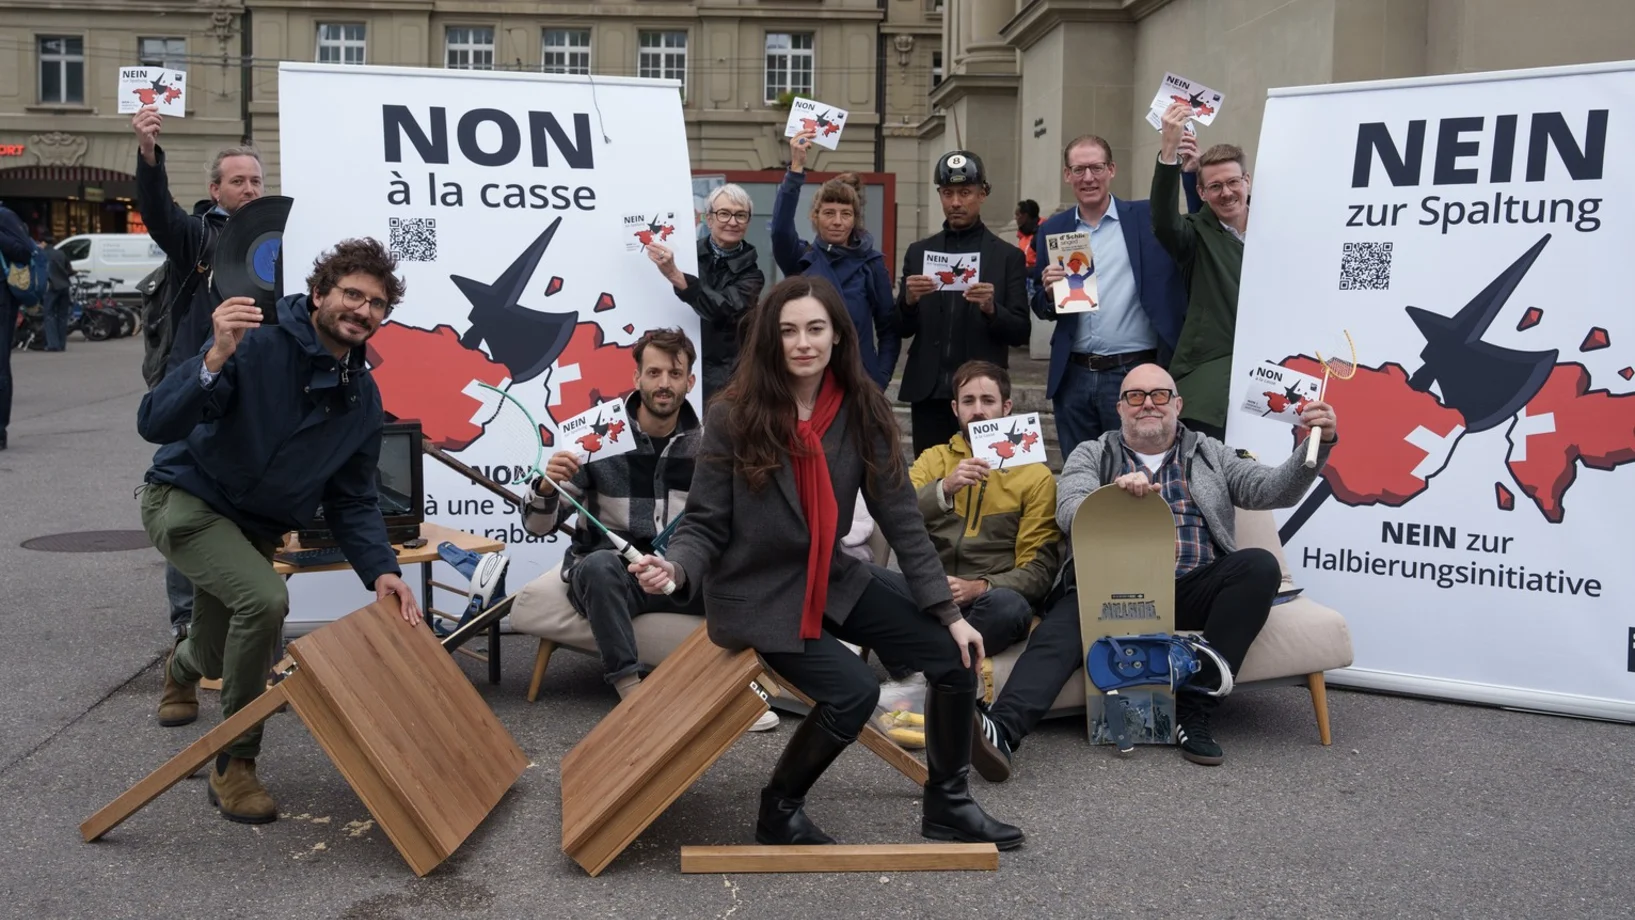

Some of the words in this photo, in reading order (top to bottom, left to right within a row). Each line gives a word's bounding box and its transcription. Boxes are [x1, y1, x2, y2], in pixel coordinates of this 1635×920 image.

[122, 70, 148, 79] NEIN
[1166, 75, 1190, 90] NEIN
[795, 101, 815, 111] NON
[382, 104, 594, 169] NON
[1351, 108, 1609, 188] NEIN
[952, 156, 961, 165] 8
[387, 170, 411, 206] à
[428, 172, 463, 207] la
[480, 183, 596, 211] casse
[624, 215, 645, 224] NEIN
[1346, 203, 1408, 227] zur
[1418, 191, 1603, 234] Spaltung
[927, 254, 949, 264] NEIN
[1256, 367, 1283, 382] NON
[563, 416, 586, 433] NEIN
[973, 423, 999, 435] NON
[424, 493, 438, 515] à
[447, 499, 494, 515] une
[1381, 521, 1457, 549] NEIN
[1466, 533, 1514, 554] zur
[1302, 546, 1602, 598] Halbierungsinitiative
